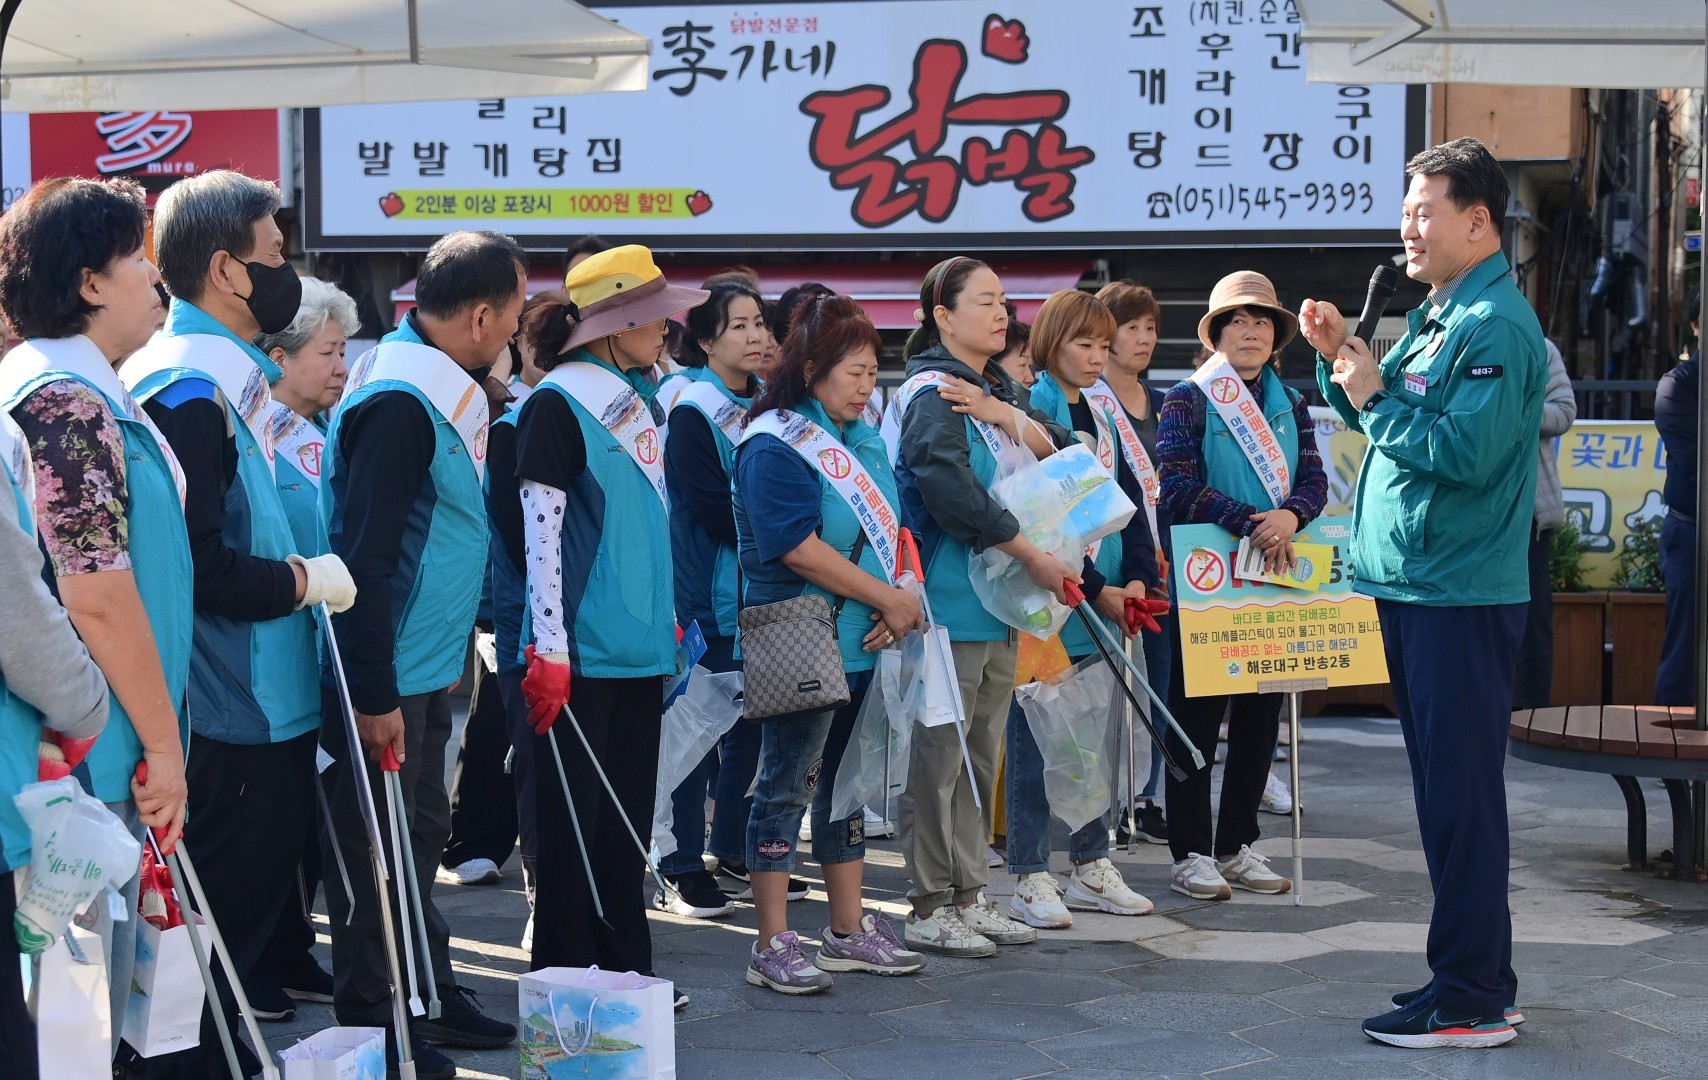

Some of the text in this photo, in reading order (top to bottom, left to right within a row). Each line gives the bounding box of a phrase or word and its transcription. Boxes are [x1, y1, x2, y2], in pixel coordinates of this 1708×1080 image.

[730, 18, 818, 34] 닭발전문점
[1194, 33, 1236, 167] 후라이드
[799, 38, 1096, 228] 닭발
[415, 193, 673, 214] 2인분 이상 포장시 1000원 할인
[1175, 182, 1373, 220] (051)545-9393
[1471, 367, 1493, 376] 해운대구
[1115, 417, 1150, 472] 담배꽁초
[1238, 399, 1281, 463] 담배꽁초
[1571, 432, 1644, 470] 꽃과
[1254, 454, 1276, 484] 해운대
[853, 472, 898, 544] 담배꽁초
[1232, 606, 1341, 626] 바다로 흘러간 담배꽁초!
[1190, 631, 1208, 645] 해양
[1212, 628, 1275, 643] 미세플라스틱이
[1278, 625, 1296, 639] 되어
[1299, 624, 1325, 637] 물고기
[1329, 622, 1355, 636] 먹이가
[1220, 638, 1358, 659] 담배꽁초 없는 아름다운 해운대
[1247, 654, 1351, 675] 해운대구 반송2동
